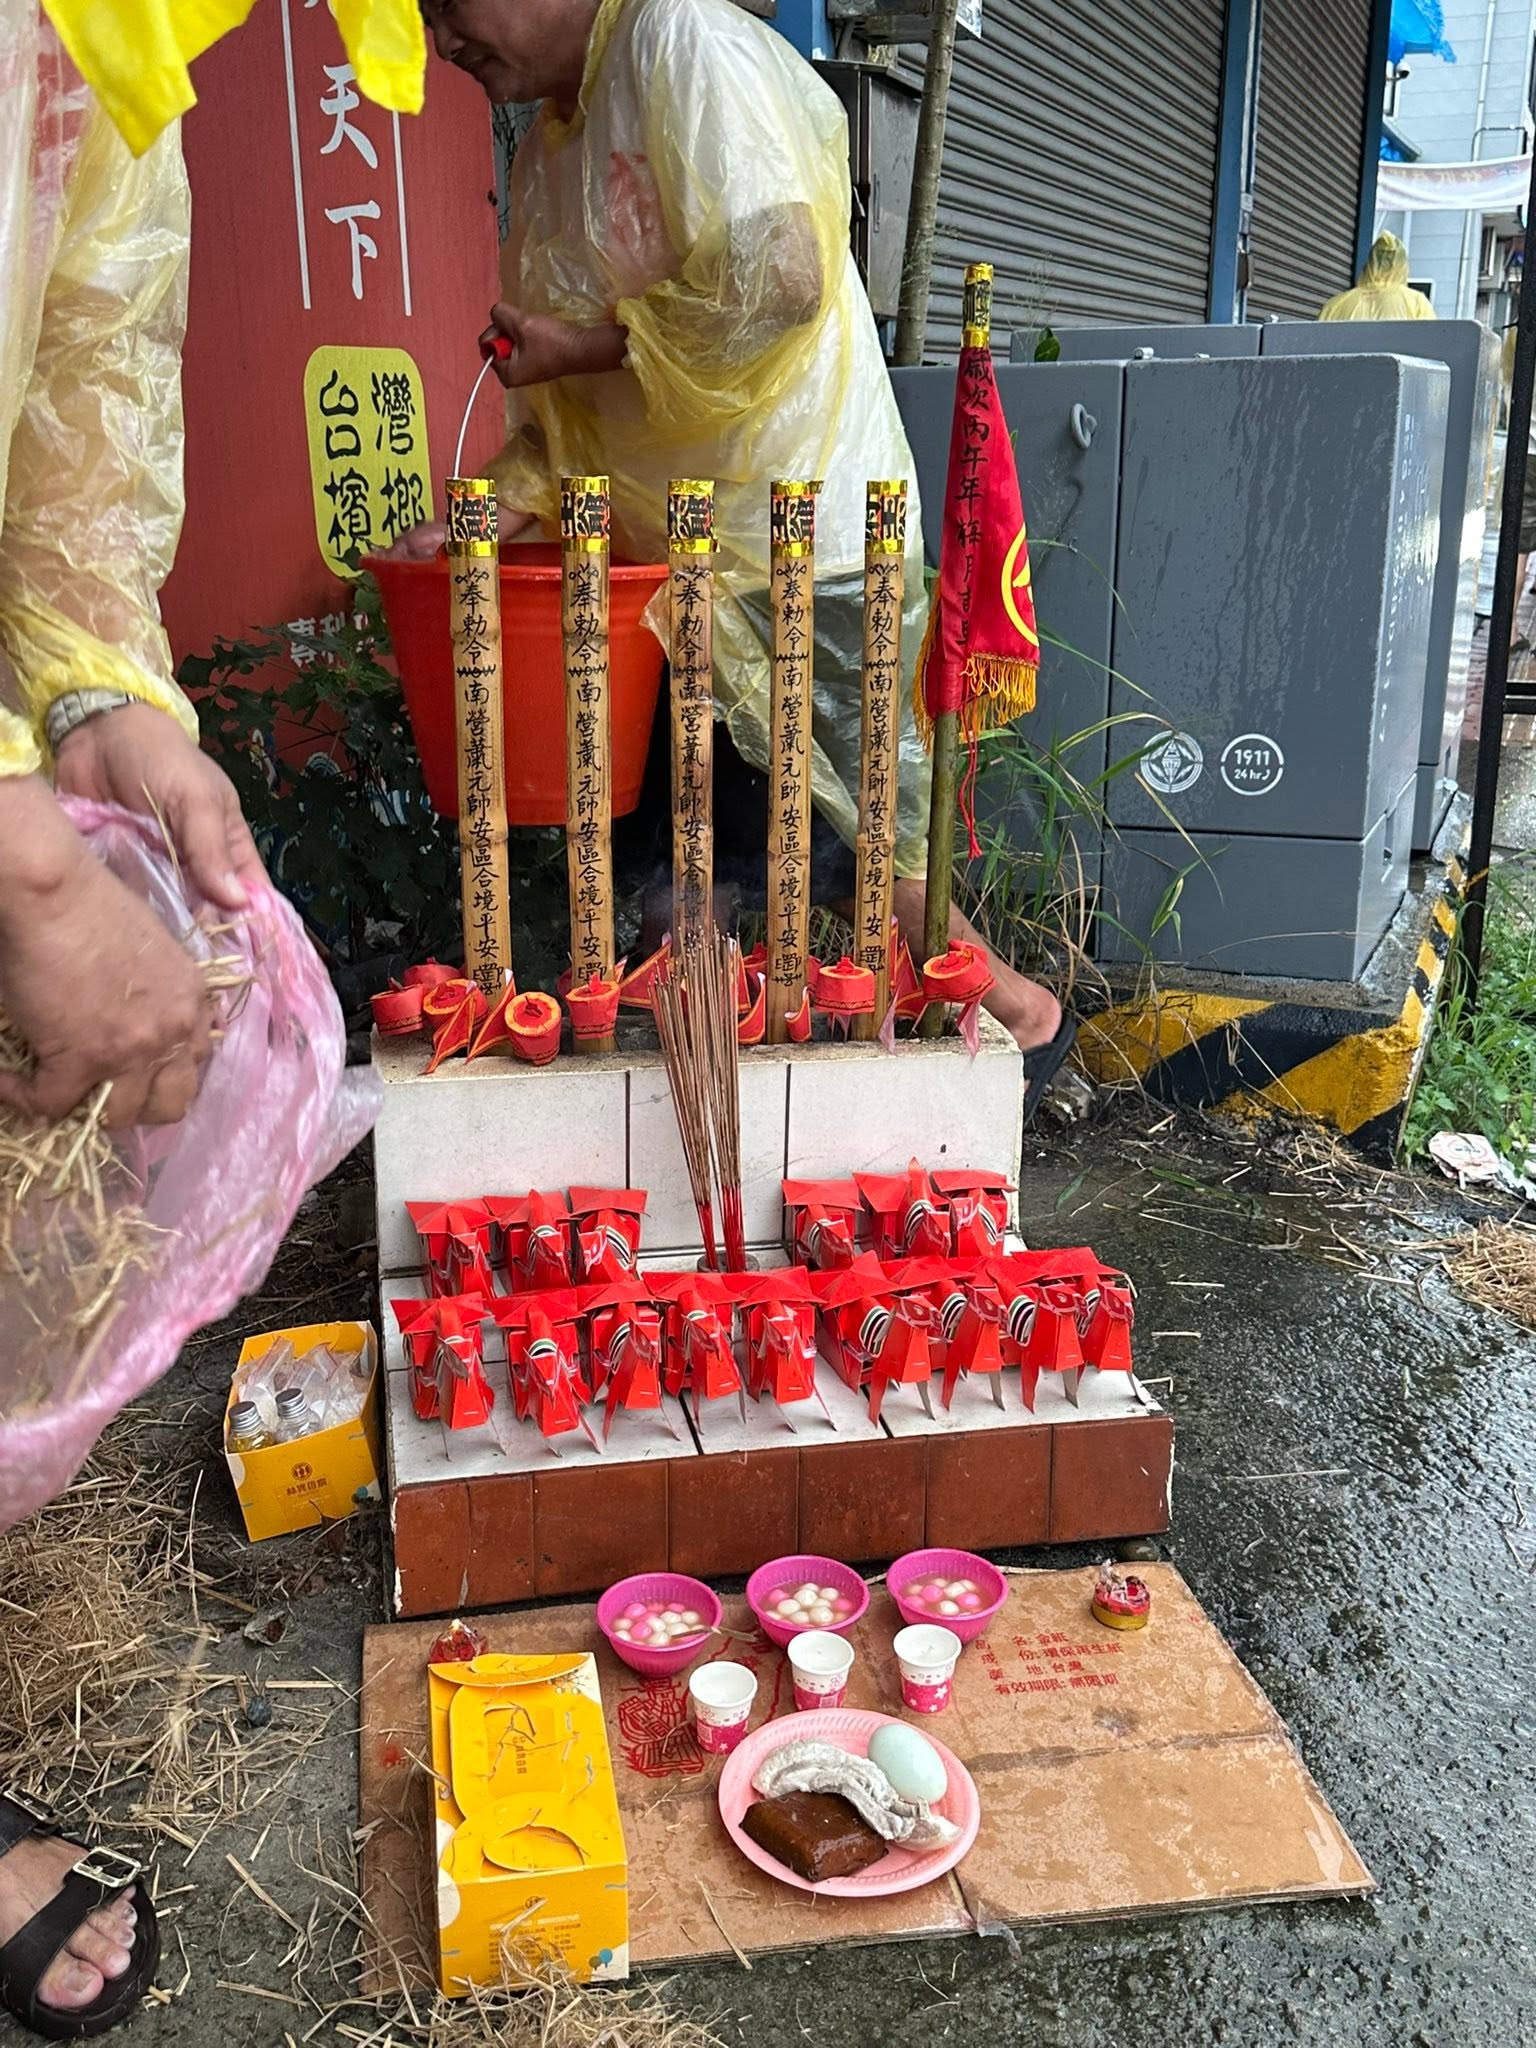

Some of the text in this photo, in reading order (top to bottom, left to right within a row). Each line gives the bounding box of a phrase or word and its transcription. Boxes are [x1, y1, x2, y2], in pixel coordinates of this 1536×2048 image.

[304, 0, 382, 300] 天下
[1234, 749, 1270, 766] 1911
[1234, 768, 1262, 780] 24 hr
